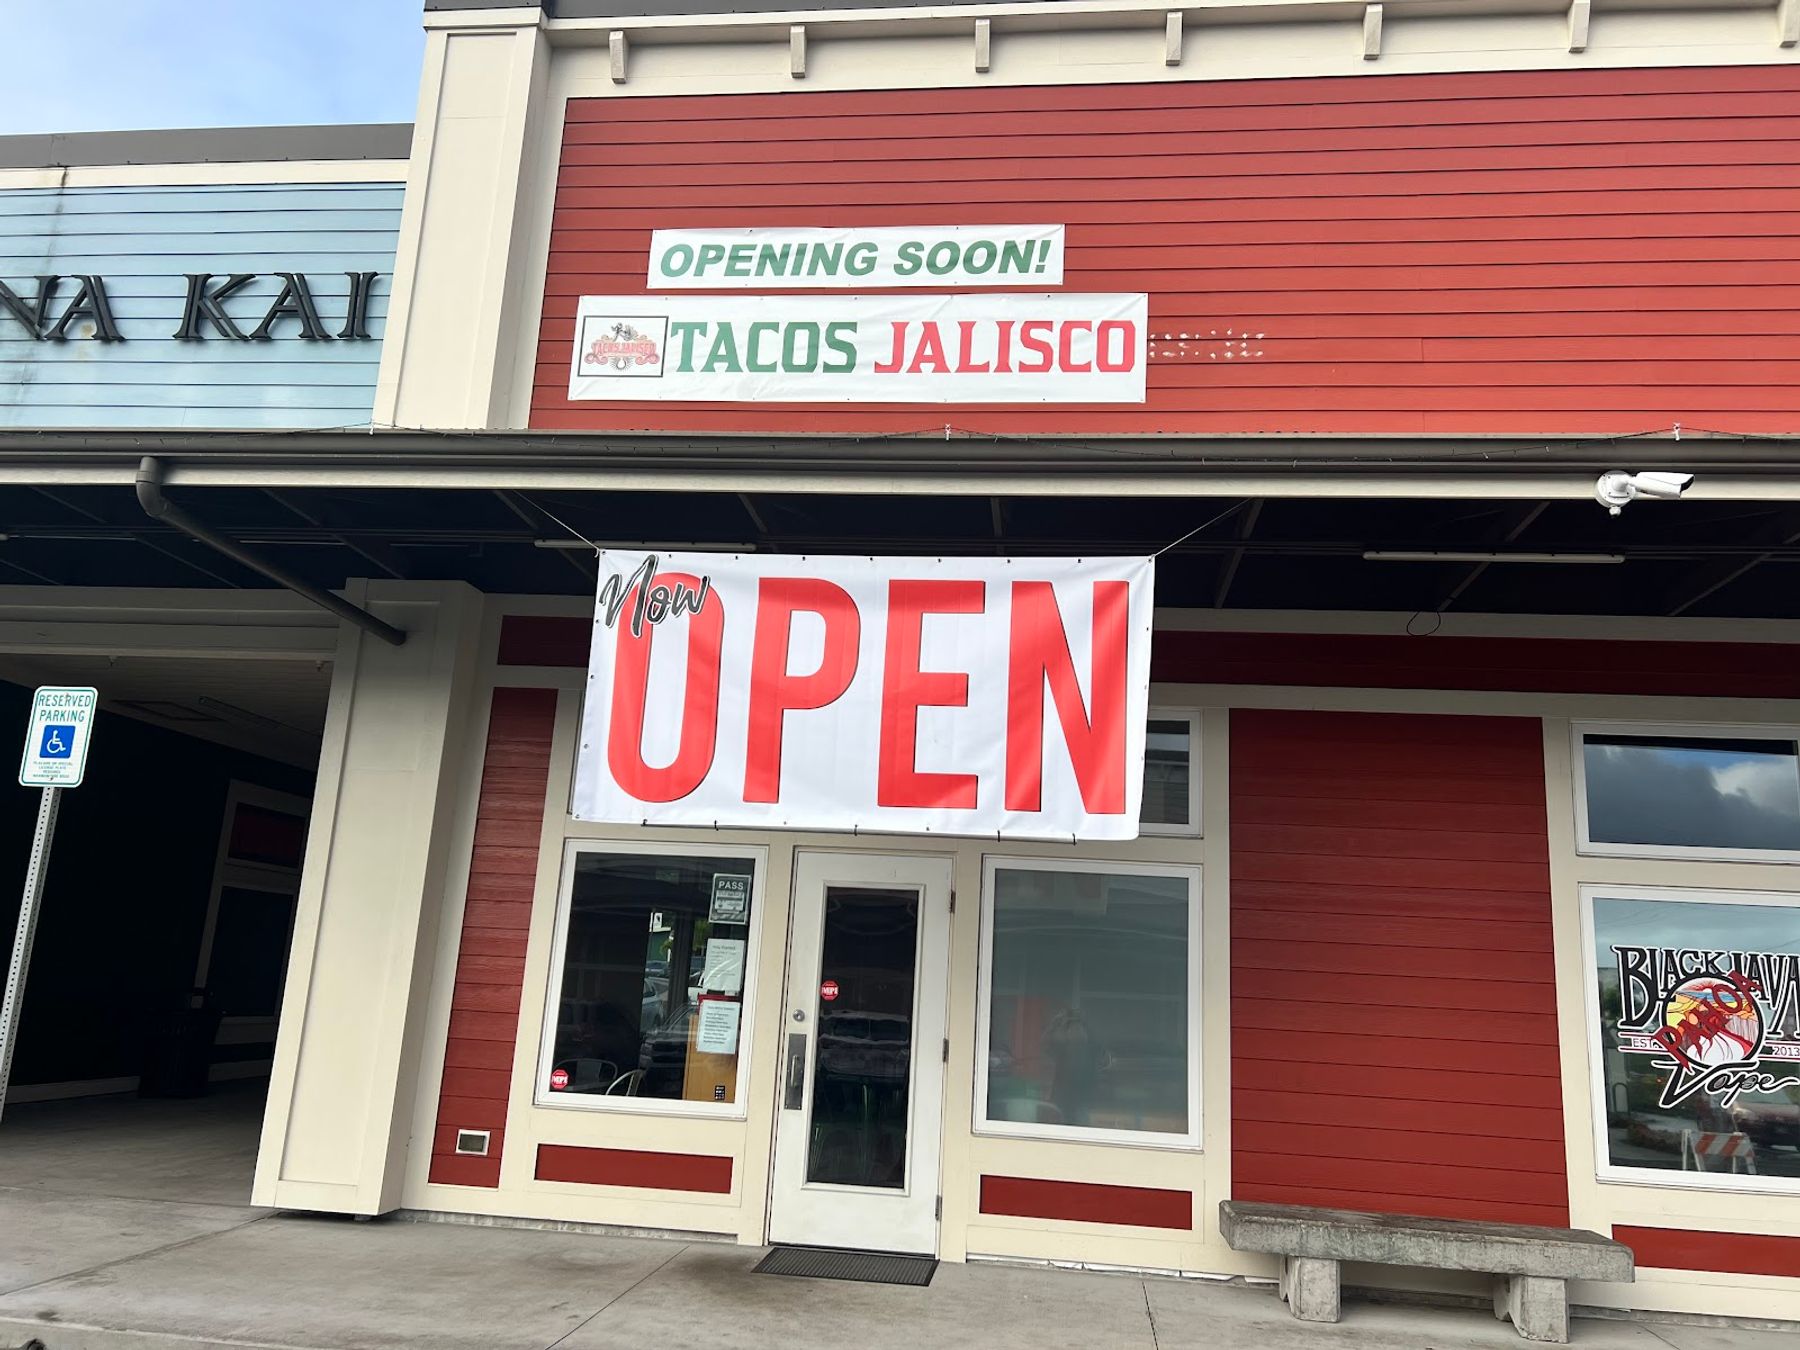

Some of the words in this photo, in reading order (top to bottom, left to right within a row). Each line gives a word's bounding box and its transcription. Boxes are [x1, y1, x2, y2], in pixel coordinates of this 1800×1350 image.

[660, 242, 879, 277] OPENING
[893, 239, 1051, 276] SOON!
[172, 271, 379, 341] KAI
[671, 321, 858, 373] TACOS
[874, 320, 1136, 374] JALISCO
[599, 554, 711, 639] Now
[38, 694, 92, 706] RESERVED
[39, 710, 85, 722] PARKING
[607, 572, 1129, 814] OPEN
[718, 880, 744, 890] PASS
[1651, 1059, 1800, 1109] Vape
